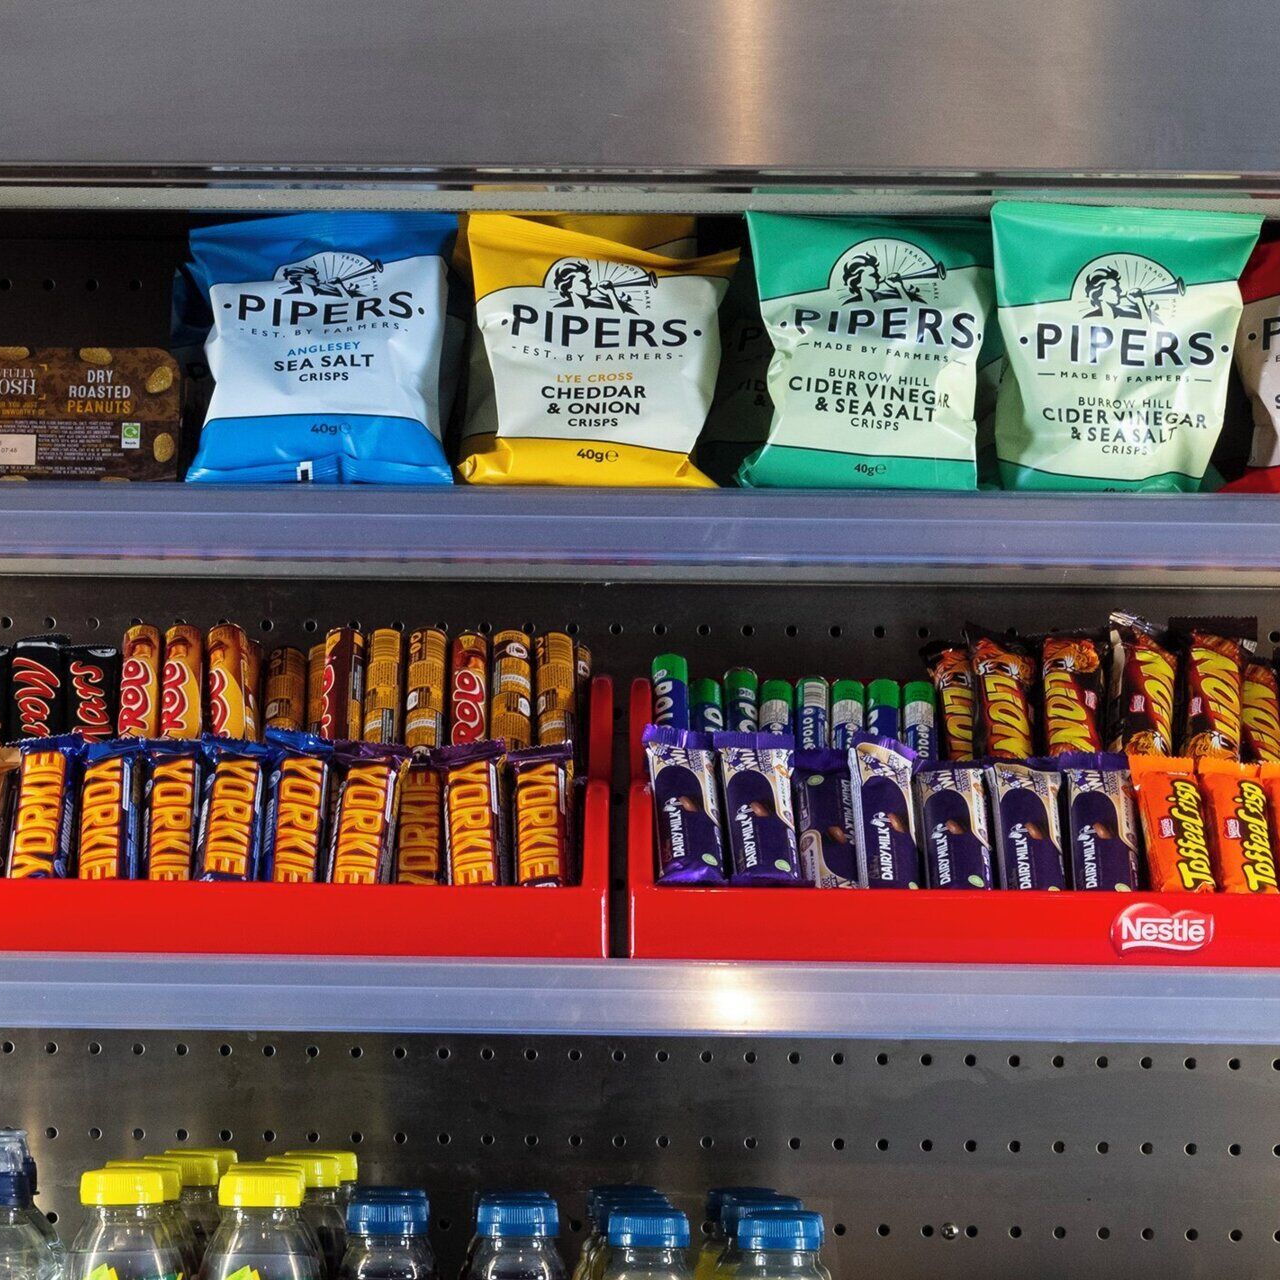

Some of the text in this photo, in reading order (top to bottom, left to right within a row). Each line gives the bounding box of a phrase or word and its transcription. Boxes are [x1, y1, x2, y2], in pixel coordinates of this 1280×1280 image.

[238, 291, 413, 326] PIPERS
[511, 304, 688, 348] PIPERS
[794, 307, 976, 349] PIPERS
[287, 341, 361, 357] ANGLESEY
[813, 341, 949, 363] MADE BY FARMERS
[1036, 323, 1214, 367] PIPERS
[274, 353, 375, 372] SEA SALT
[595, 352, 673, 361] FARMERS
[87, 369, 113, 383] DRY
[299, 372, 349, 382] CRISPS
[556, 372, 633, 384] LYE CROSS
[829, 367, 930, 387] BURROW HILL
[69, 386, 131, 399] ROASTED
[541, 386, 646, 399] CHEDDAR
[789, 377, 950, 409] CIDER VINEGAR
[67, 400, 131, 414] PEANUTS
[547, 402, 640, 415] & ONION
[815, 397, 936, 422] & SEA SALT
[567, 418, 619, 427] CRISPS
[850, 418, 899, 431] CRISPS
[1043, 408, 1207, 429] CIDER VINEGAR
[1044, 673, 1095, 752] LION
[13, 752, 64, 877] YORKIE
[204, 761, 257, 874] YORKIE
[517, 763, 560, 881] YORKIE
